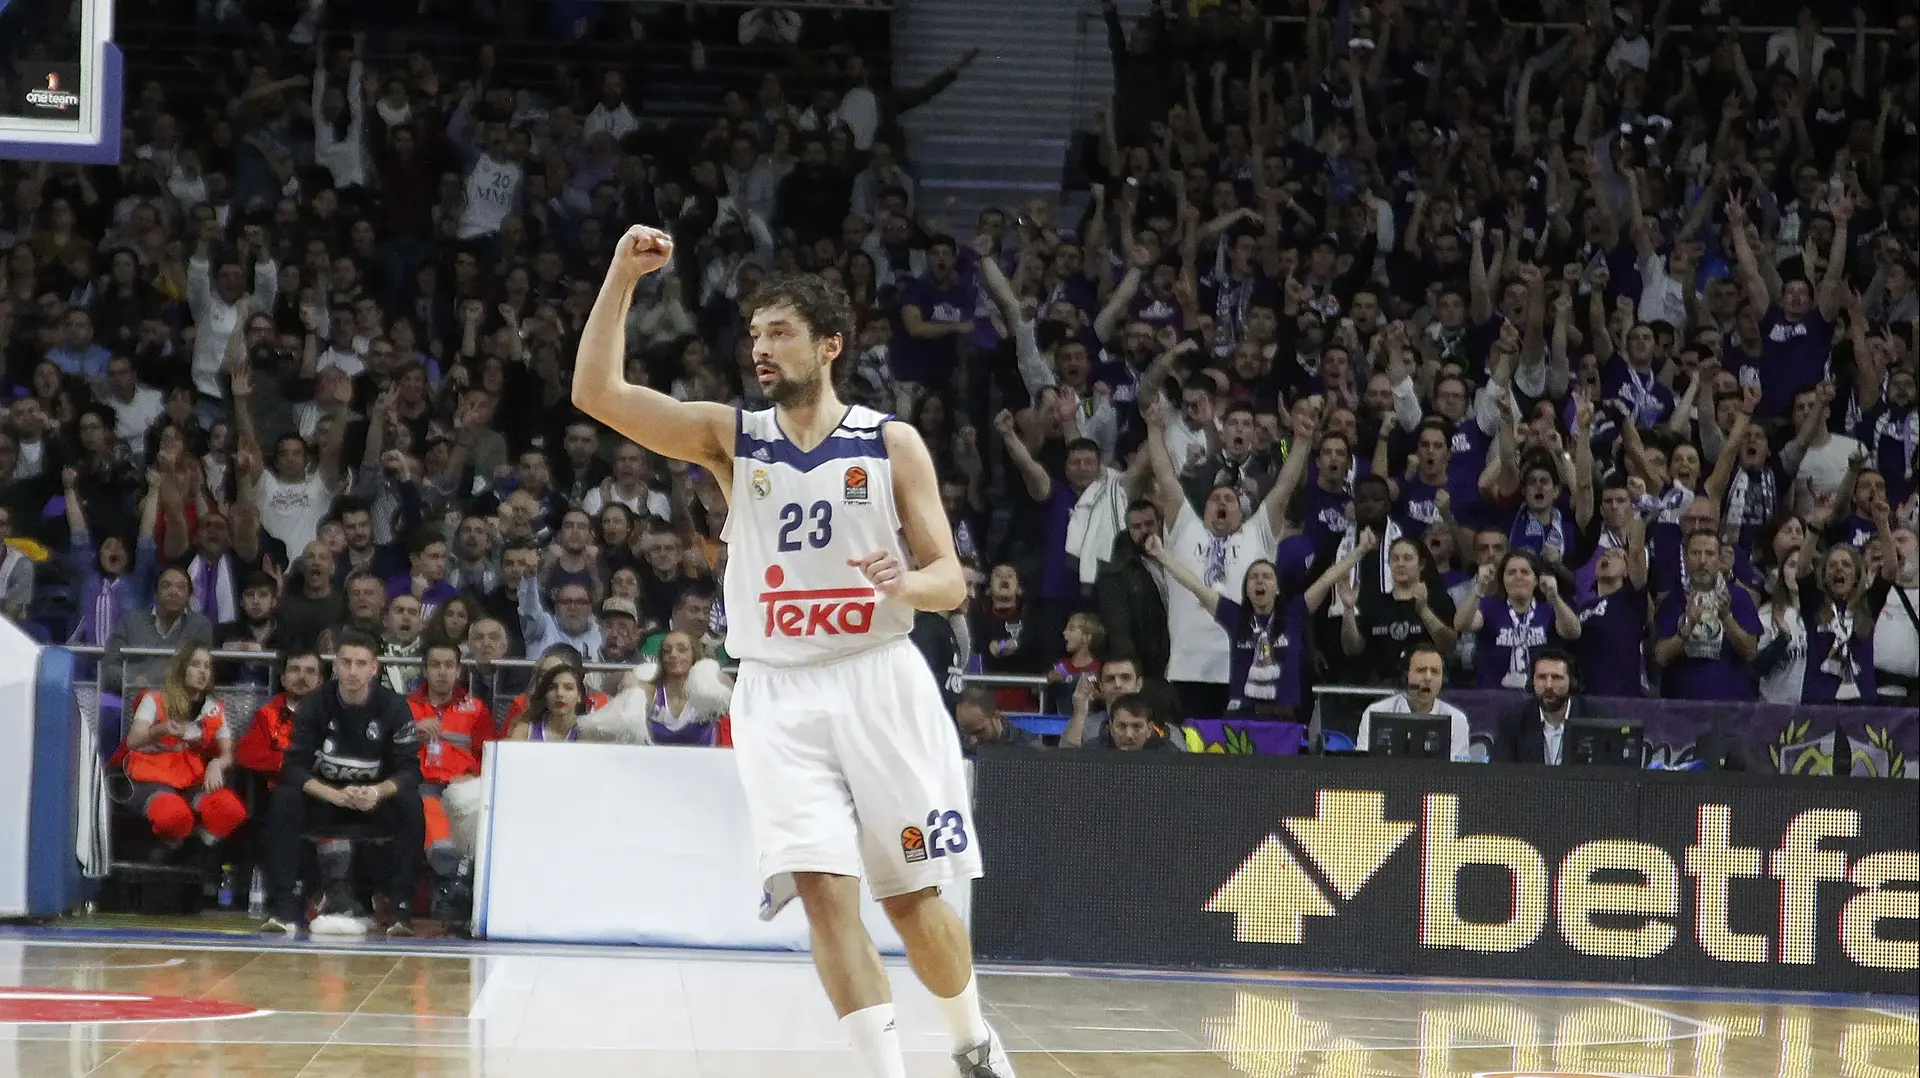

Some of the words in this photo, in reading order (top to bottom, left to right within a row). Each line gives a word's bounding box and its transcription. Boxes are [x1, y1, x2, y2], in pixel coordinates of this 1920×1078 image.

[26, 93, 47, 103] one
[49, 93, 78, 105] team
[491, 172, 510, 189] 20
[778, 500, 832, 552] 23
[926, 808, 968, 858] 23
[1419, 794, 1919, 969] betfa
